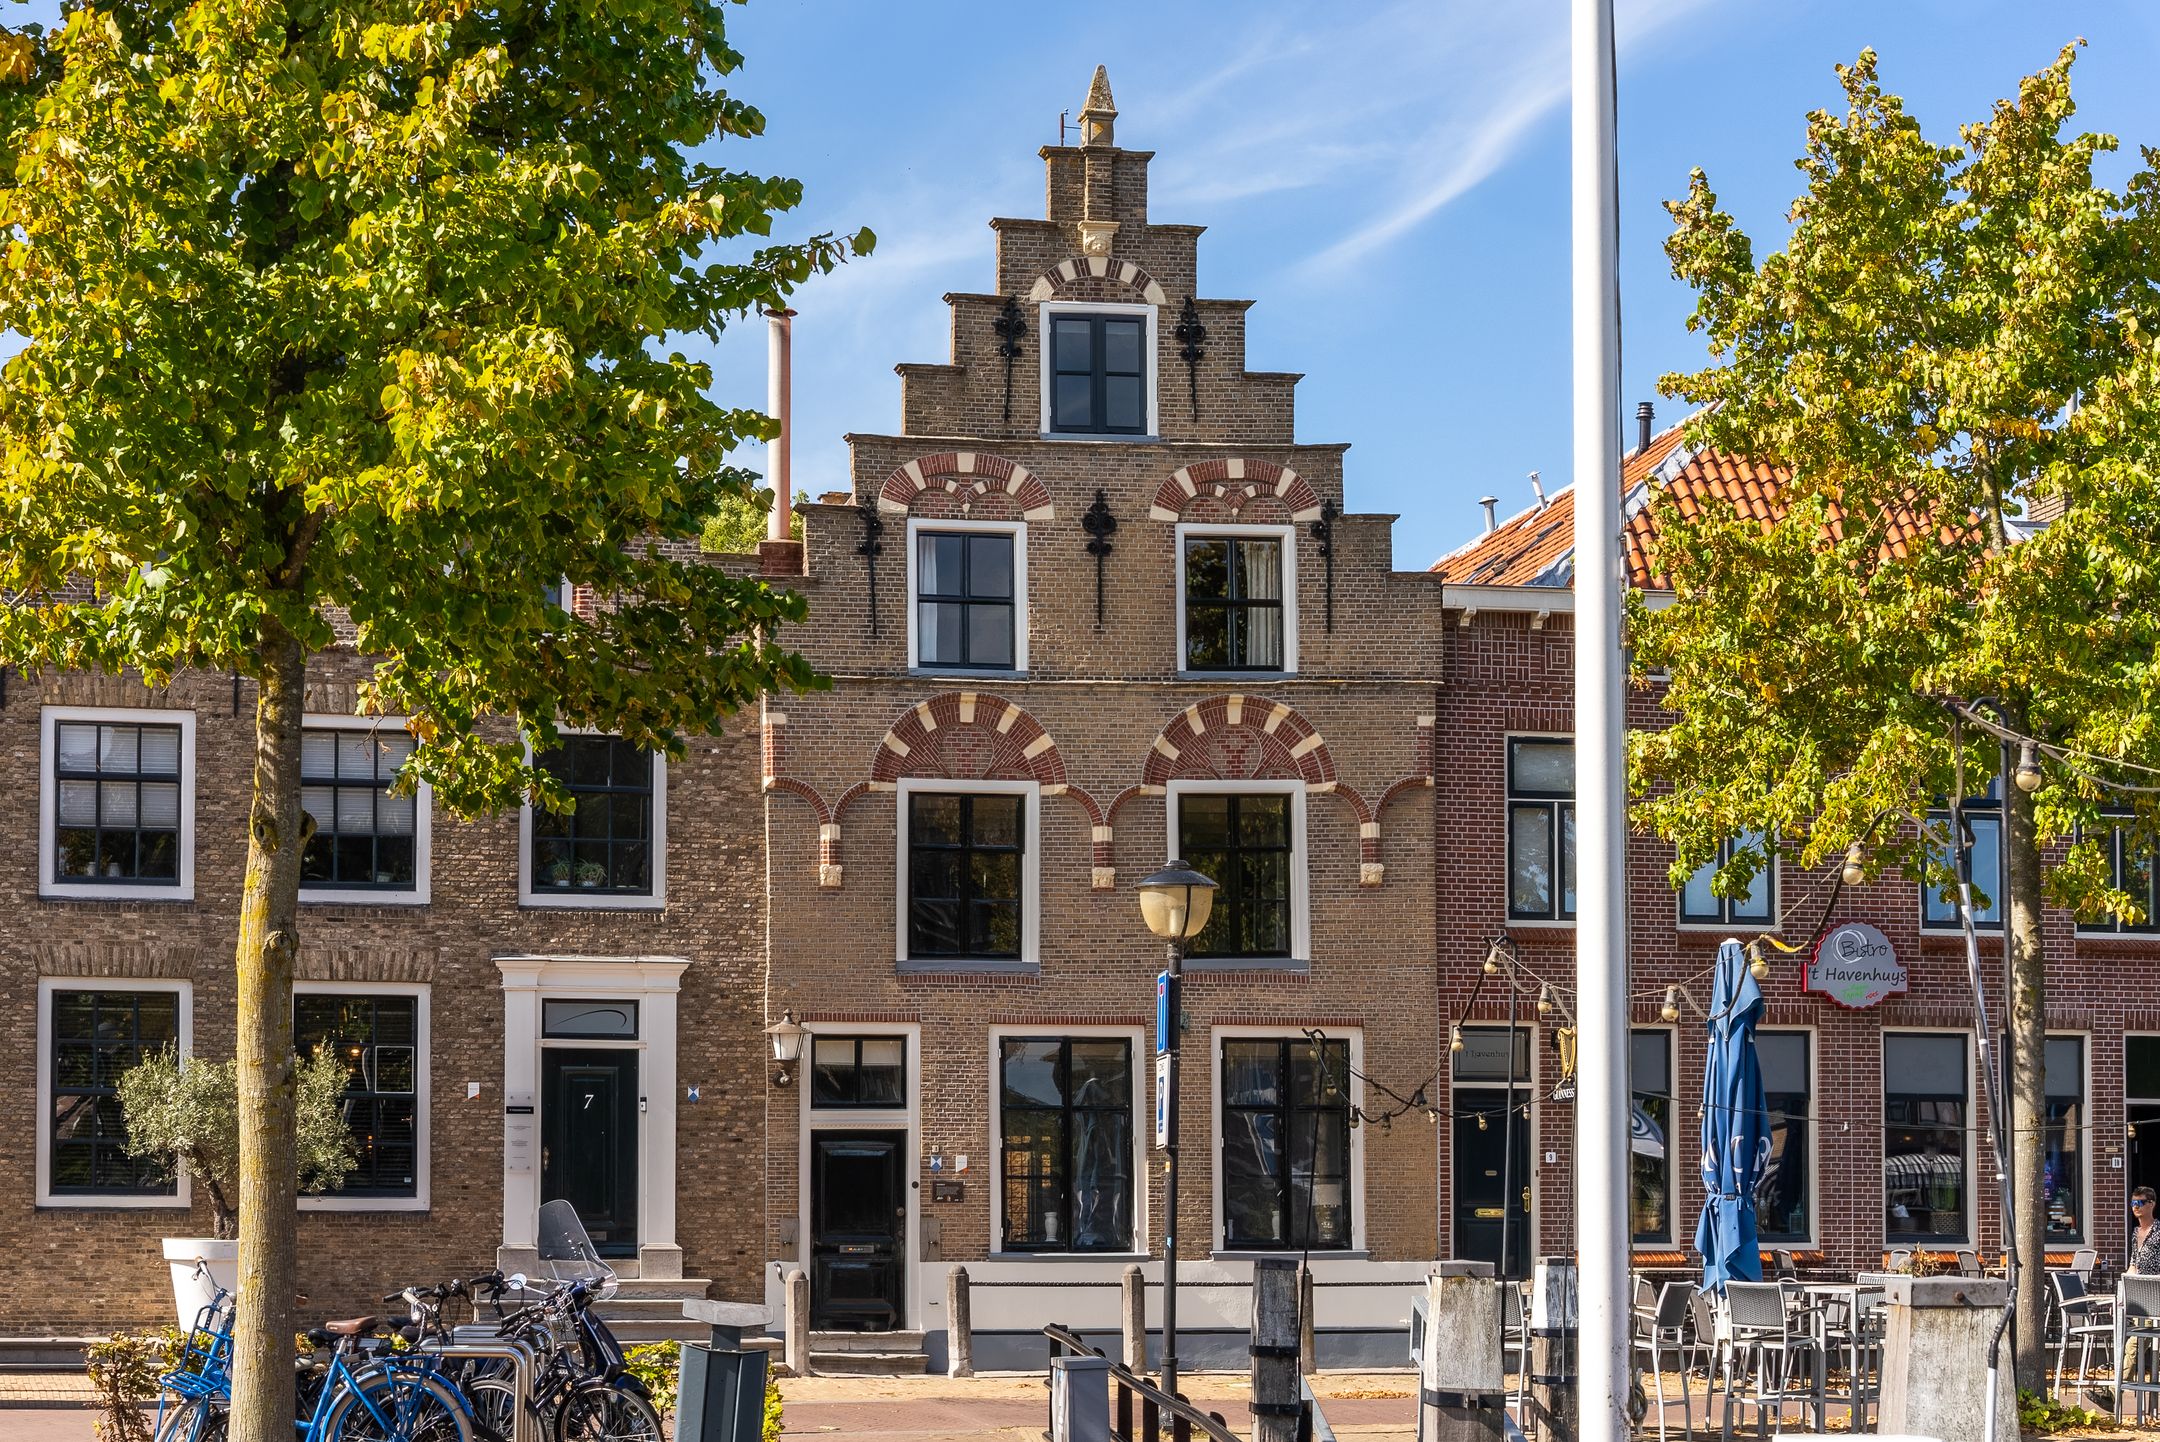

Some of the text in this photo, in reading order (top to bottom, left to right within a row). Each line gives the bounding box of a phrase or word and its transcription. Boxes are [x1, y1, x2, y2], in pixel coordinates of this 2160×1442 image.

[1841, 939, 1888, 958] Bistro
[1808, 967, 1907, 987] 't Havenhuys
[584, 1094, 594, 1109] 7
